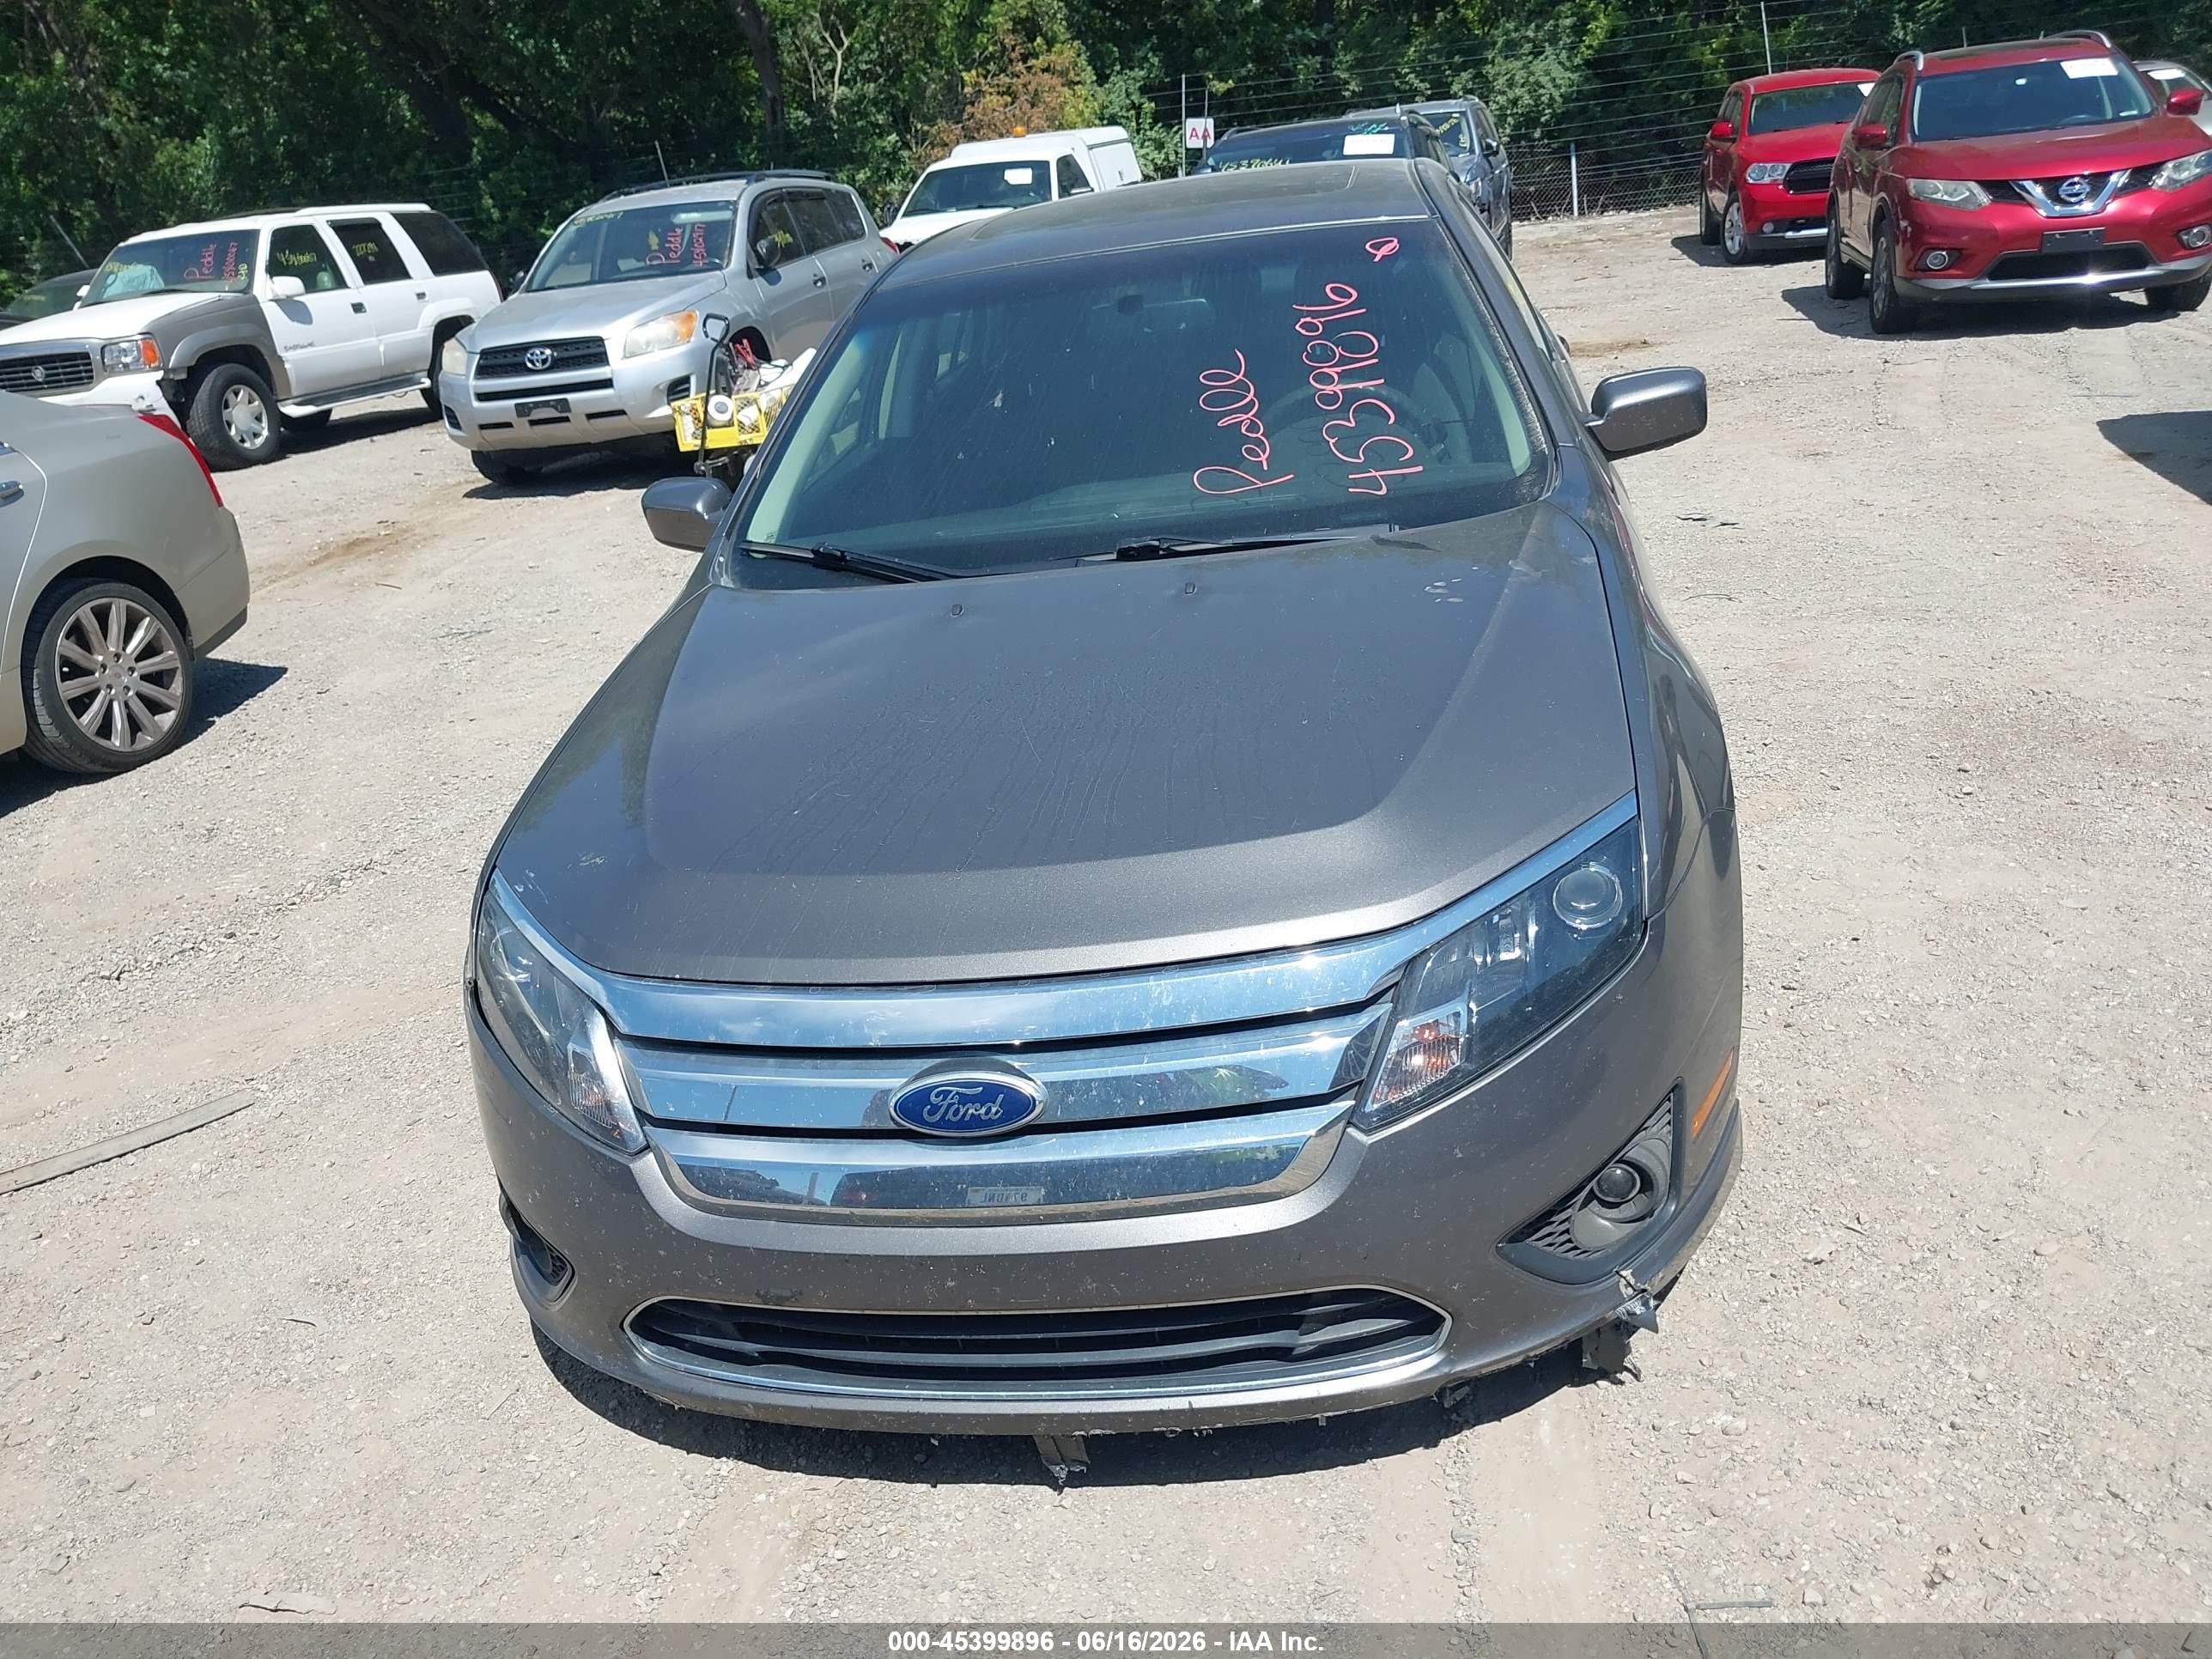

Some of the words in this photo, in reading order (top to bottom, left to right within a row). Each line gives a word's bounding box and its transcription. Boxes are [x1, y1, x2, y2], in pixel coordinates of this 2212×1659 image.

[1188, 127, 1212, 140] AA
[1291, 282, 1424, 496] 45399896
[921, 1086, 1005, 1123] Ford
